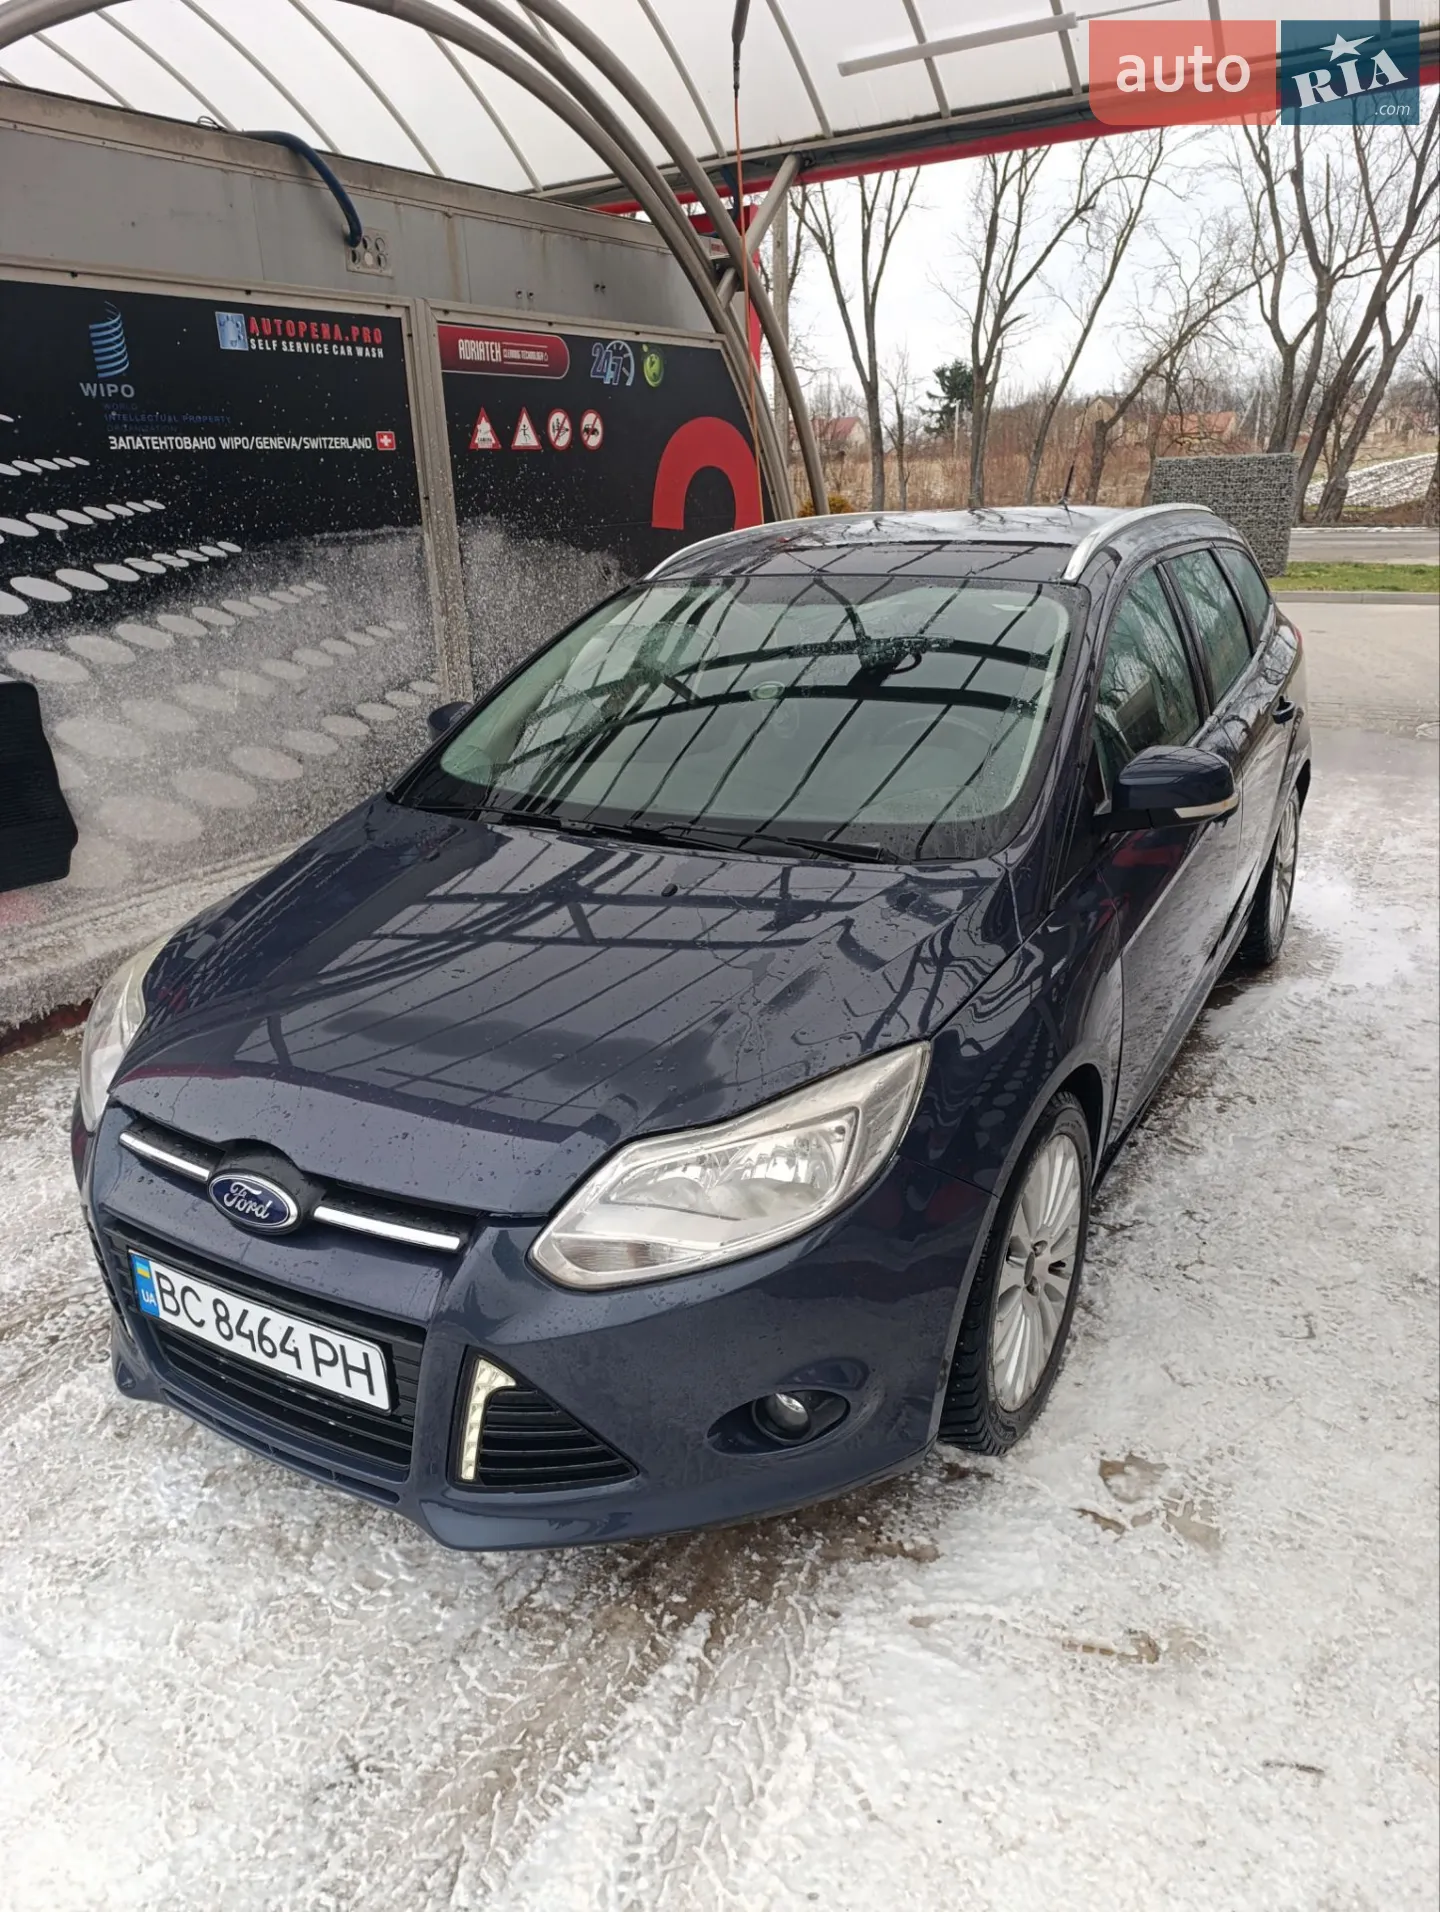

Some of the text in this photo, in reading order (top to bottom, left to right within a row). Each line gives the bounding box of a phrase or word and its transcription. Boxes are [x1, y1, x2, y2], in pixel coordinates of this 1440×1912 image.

[250, 338, 384, 359] SELF SERVICE CAR WASH
[80, 382, 136, 399] WIPO
[104, 413, 232, 424] INTELLECTUAL PROPERTY
[108, 435, 372, 450] ЗАПАТЕНТОВАНО WIPO/GENEVA/SWITZERLAND
[224, 1181, 270, 1219] Ford
[142, 1290, 157, 1306] UA
[155, 1270, 375, 1396] BC 8464 PH
